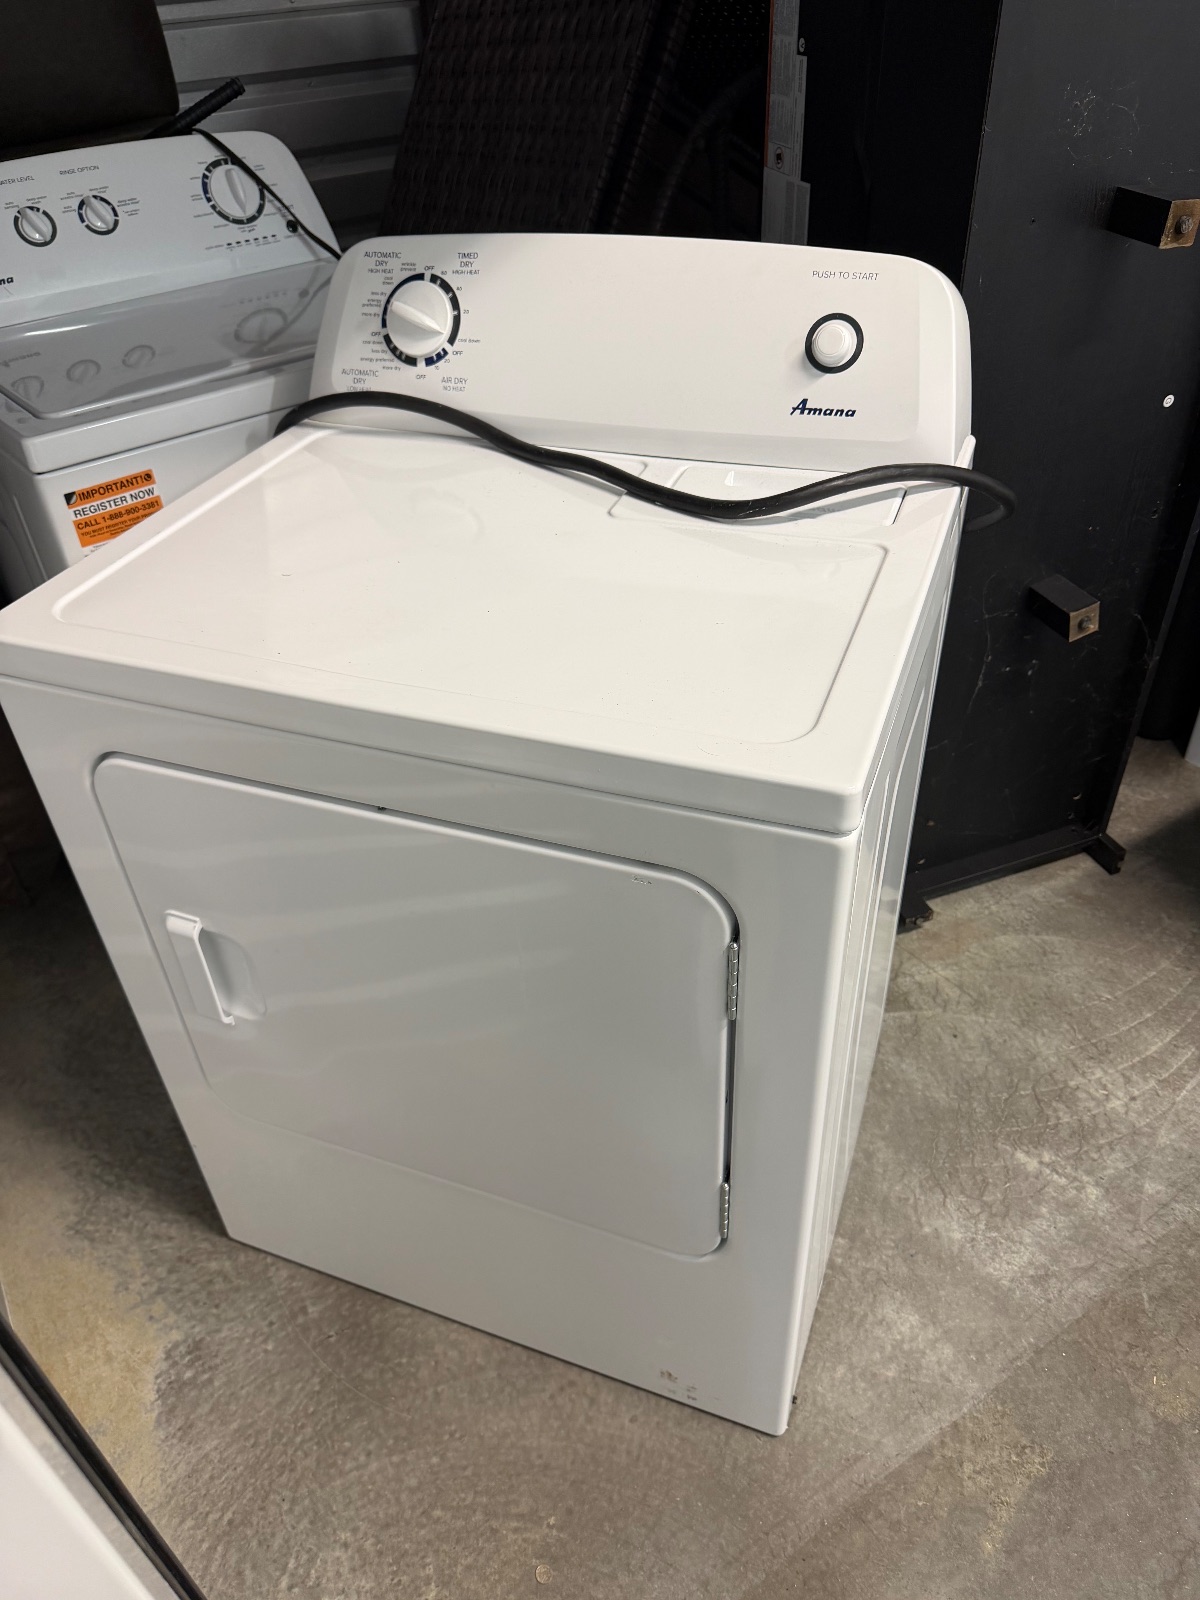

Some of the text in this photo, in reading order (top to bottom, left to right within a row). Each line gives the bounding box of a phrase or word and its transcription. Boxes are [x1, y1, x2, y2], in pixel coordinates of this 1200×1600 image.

[364, 251, 402, 259] AUTOMATIC
[812, 270, 879, 281] PUSH TO START
[341, 368, 379, 377] AUTOMATIC
[441, 376, 468, 385] AIR DRY
[790, 398, 857, 417] Amana
[78, 475, 144, 501] IMPORTANT!
[73, 486, 155, 518] REGISTER NOW
[77, 518, 101, 530] CALL
